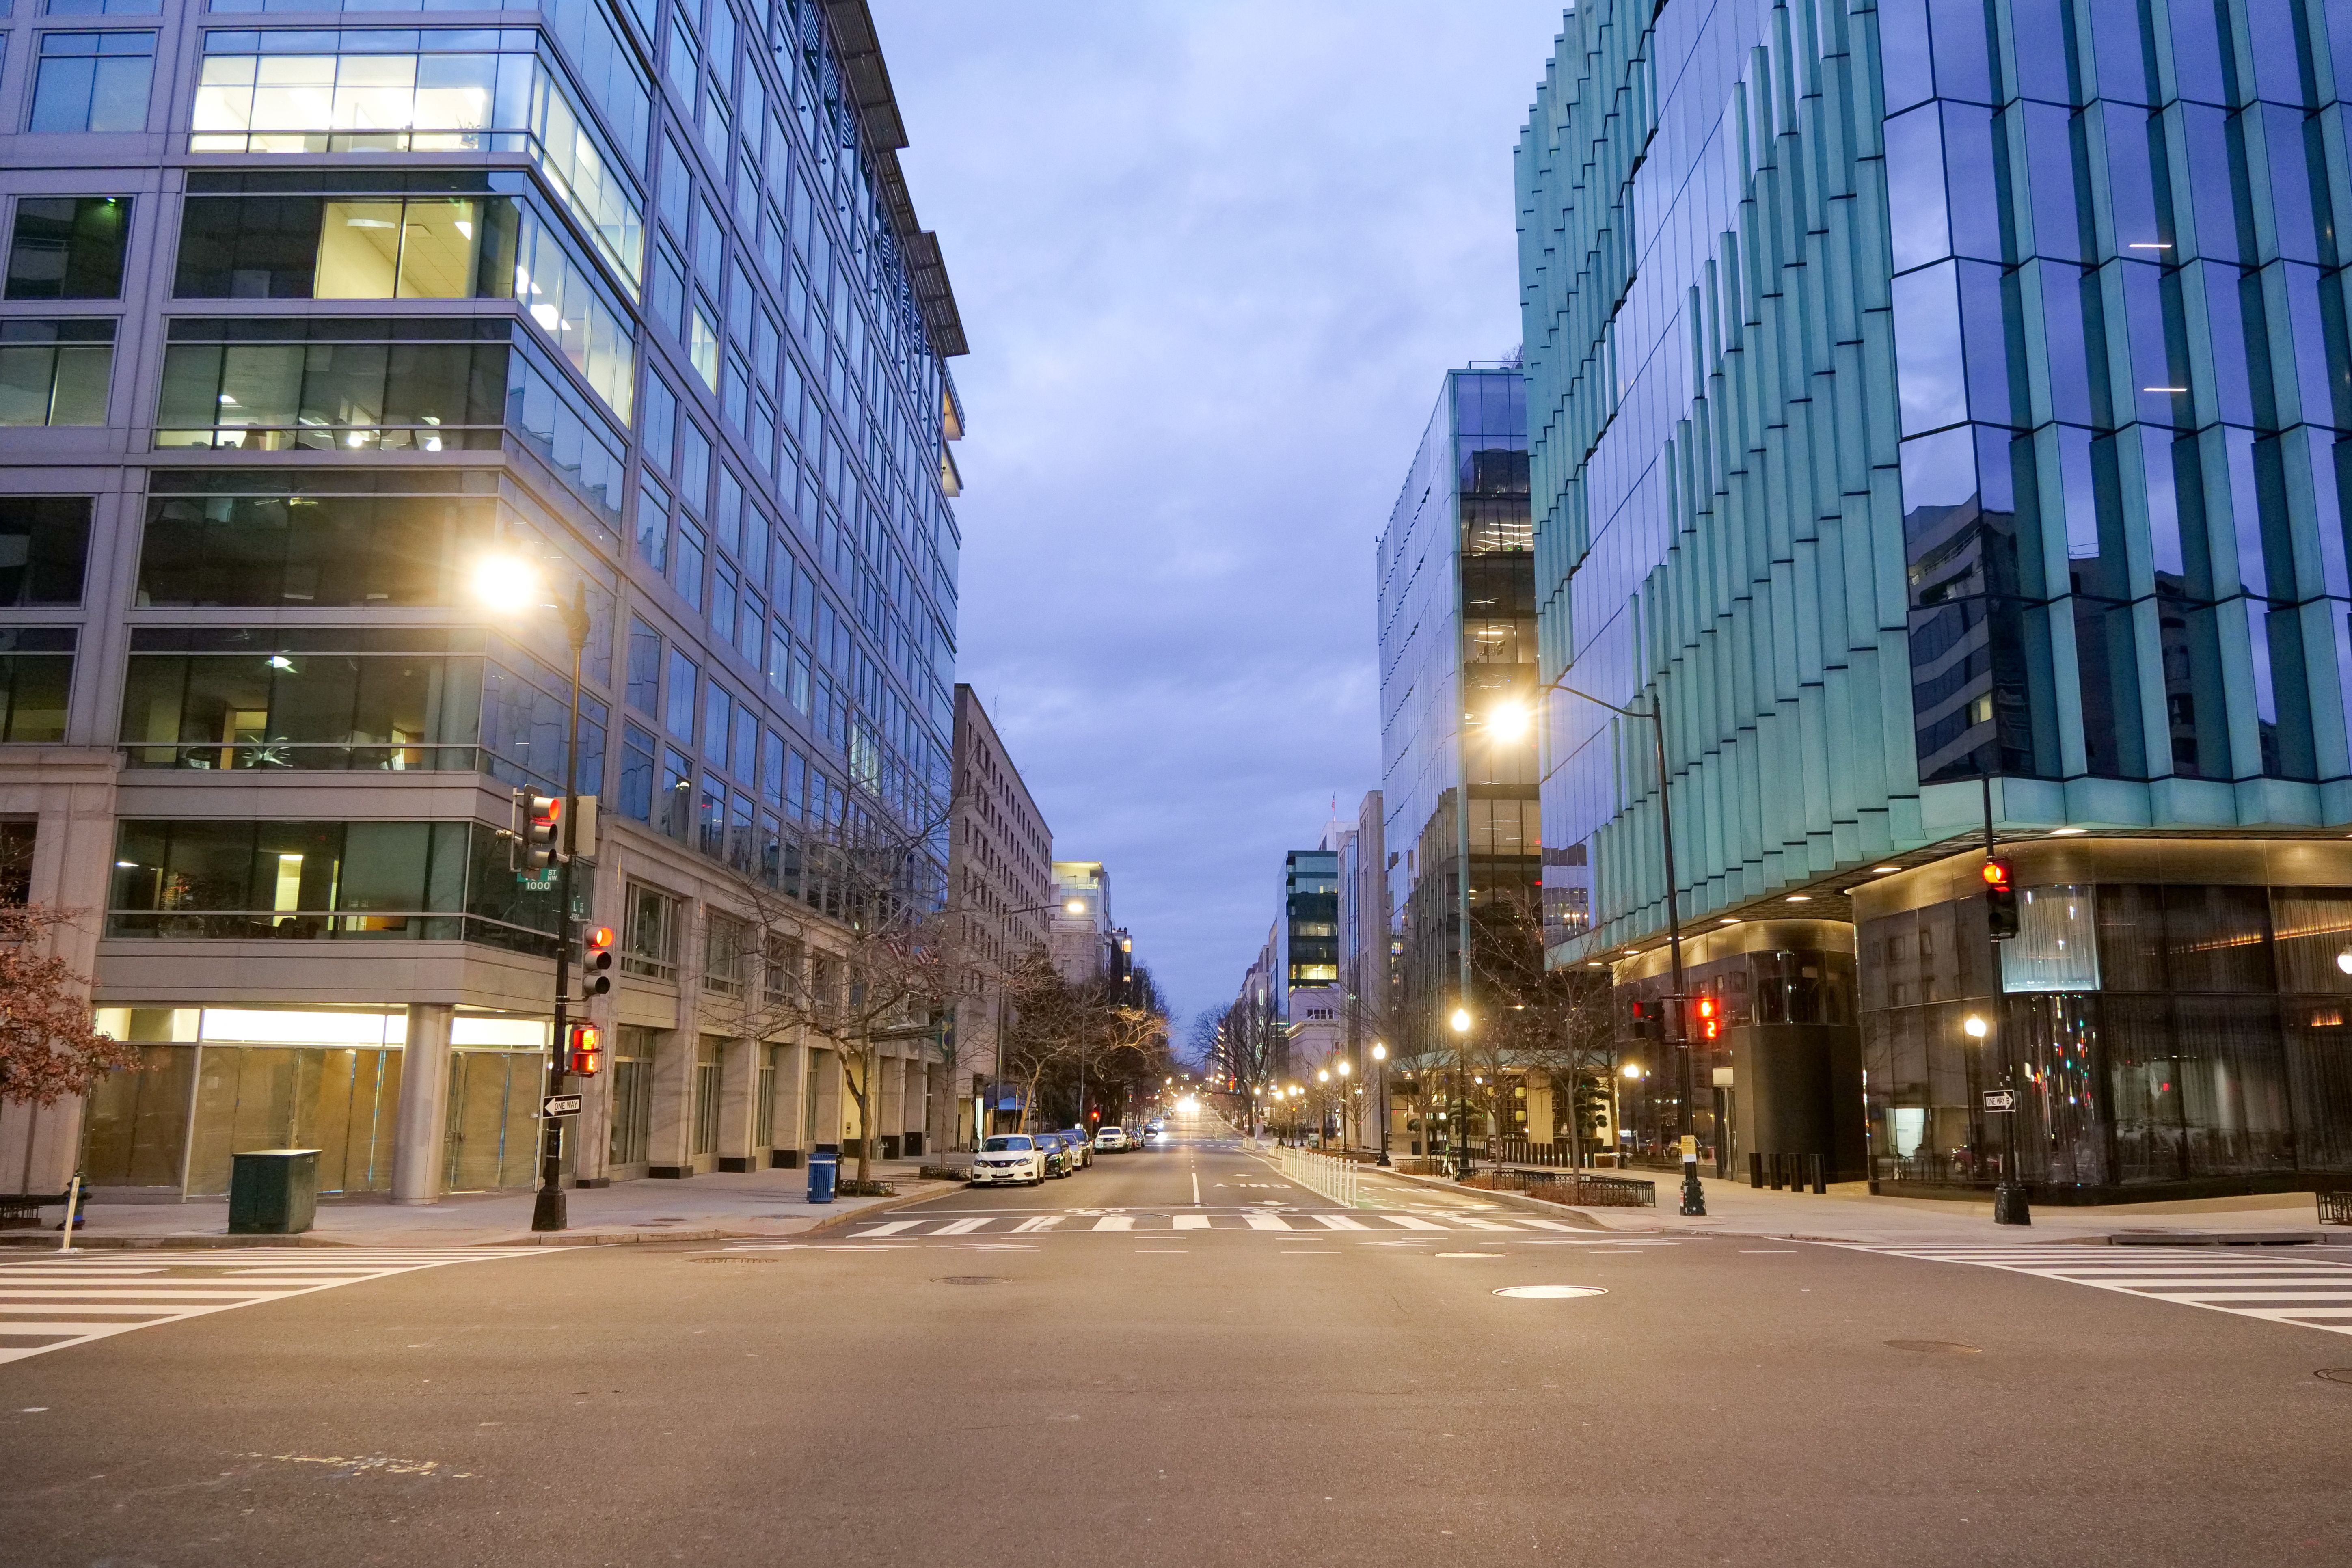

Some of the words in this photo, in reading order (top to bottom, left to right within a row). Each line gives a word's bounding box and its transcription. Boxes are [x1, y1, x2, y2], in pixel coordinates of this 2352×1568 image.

[573, 901, 577, 912] L
[1708, 1022, 1715, 1036] 2
[555, 1102, 565, 1110] ONE
[567, 1101, 578, 1109] WAY
